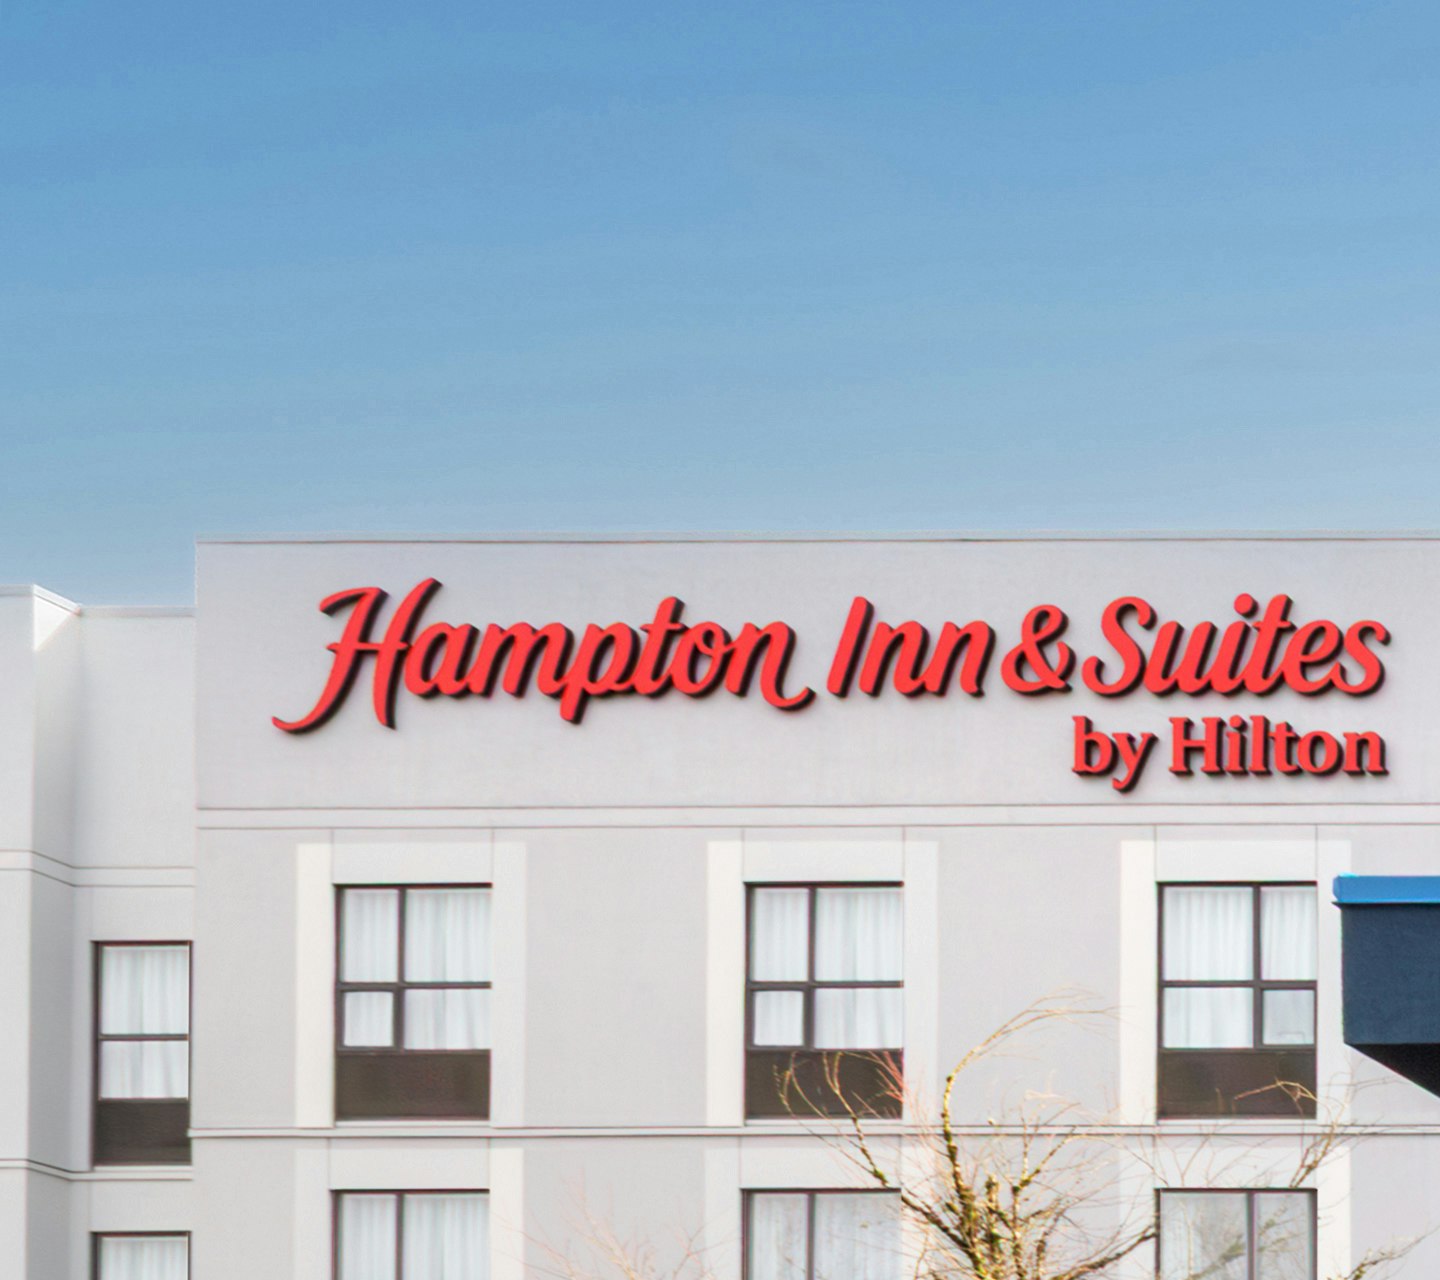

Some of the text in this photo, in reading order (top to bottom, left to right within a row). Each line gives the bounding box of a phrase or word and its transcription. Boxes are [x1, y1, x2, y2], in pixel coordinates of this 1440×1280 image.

[271, 577, 1390, 734] Hampton Inn & Suites
[1071, 714, 1386, 791] by Hilton
